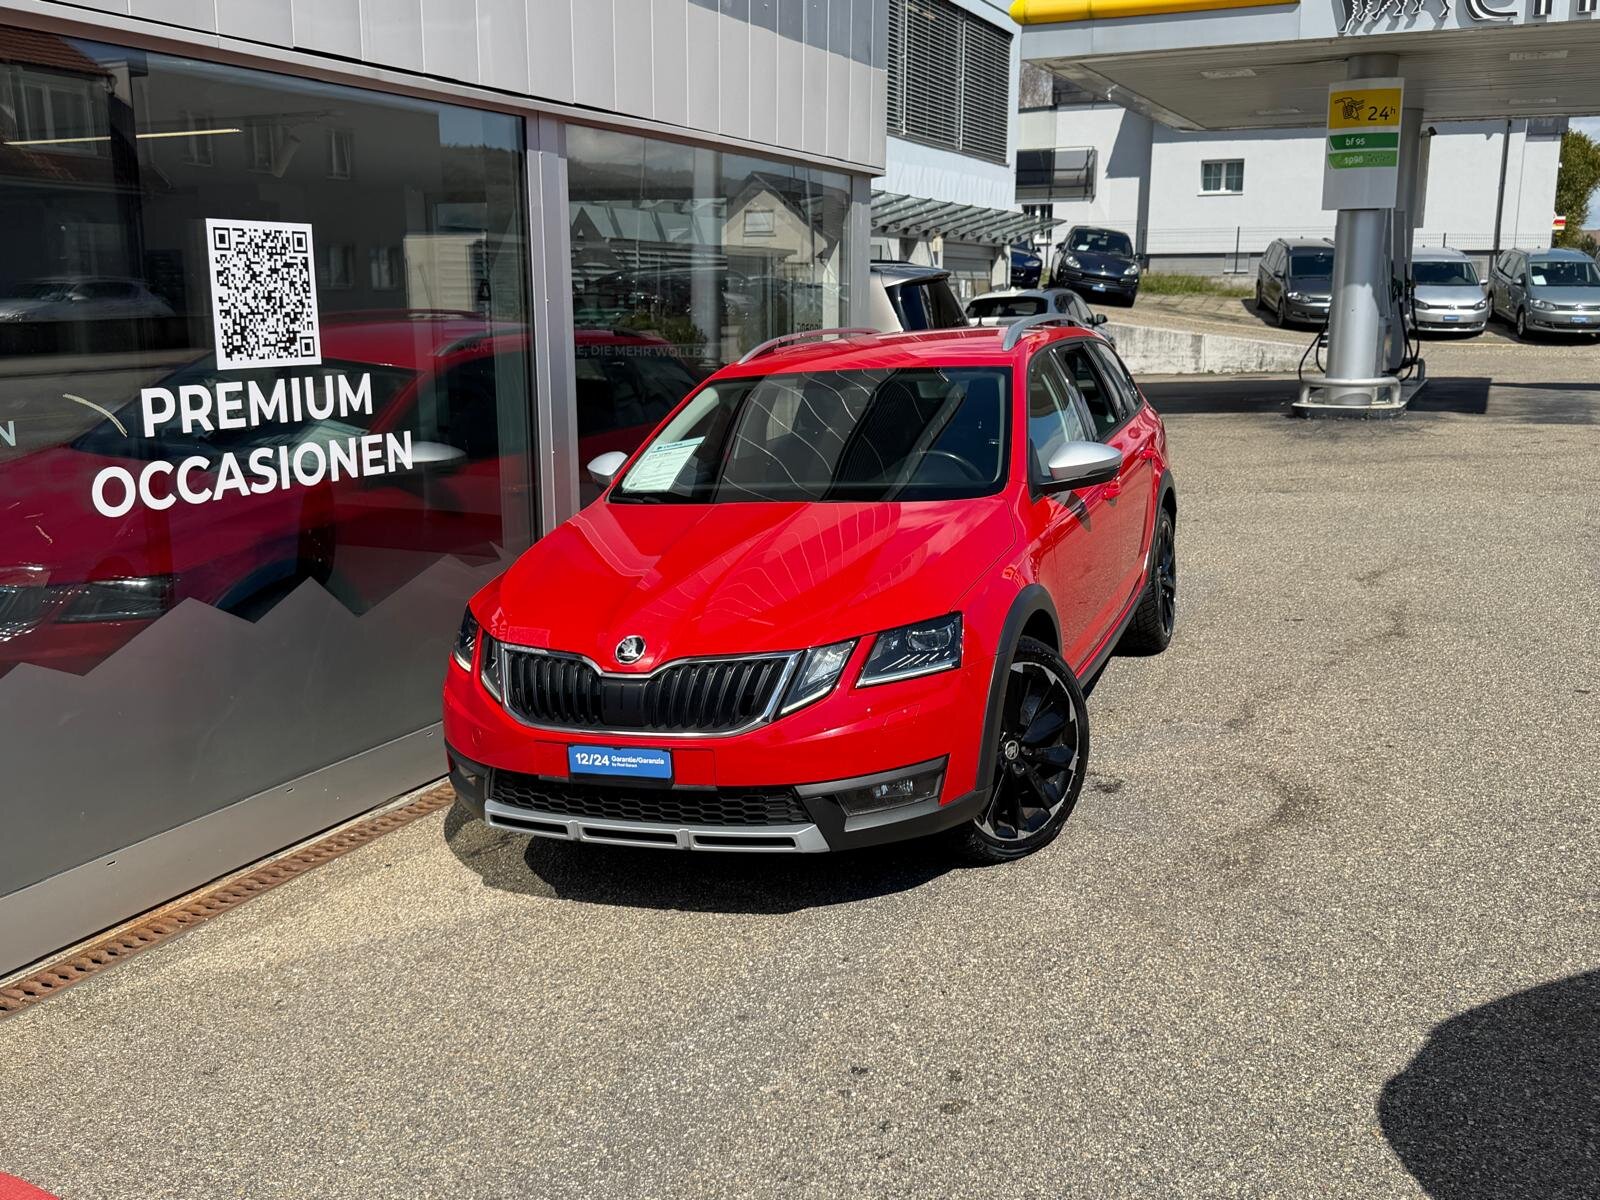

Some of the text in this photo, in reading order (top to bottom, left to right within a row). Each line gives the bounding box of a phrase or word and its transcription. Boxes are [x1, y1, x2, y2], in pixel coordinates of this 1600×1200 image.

[1355, 137, 1366, 146] 95
[591, 345, 612, 356] DIE
[615, 345, 652, 357] MEHR
[140, 373, 373, 439] PREMIUM
[91, 430, 413, 518] OCCASIONEN
[575, 752, 610, 767] 12/24
